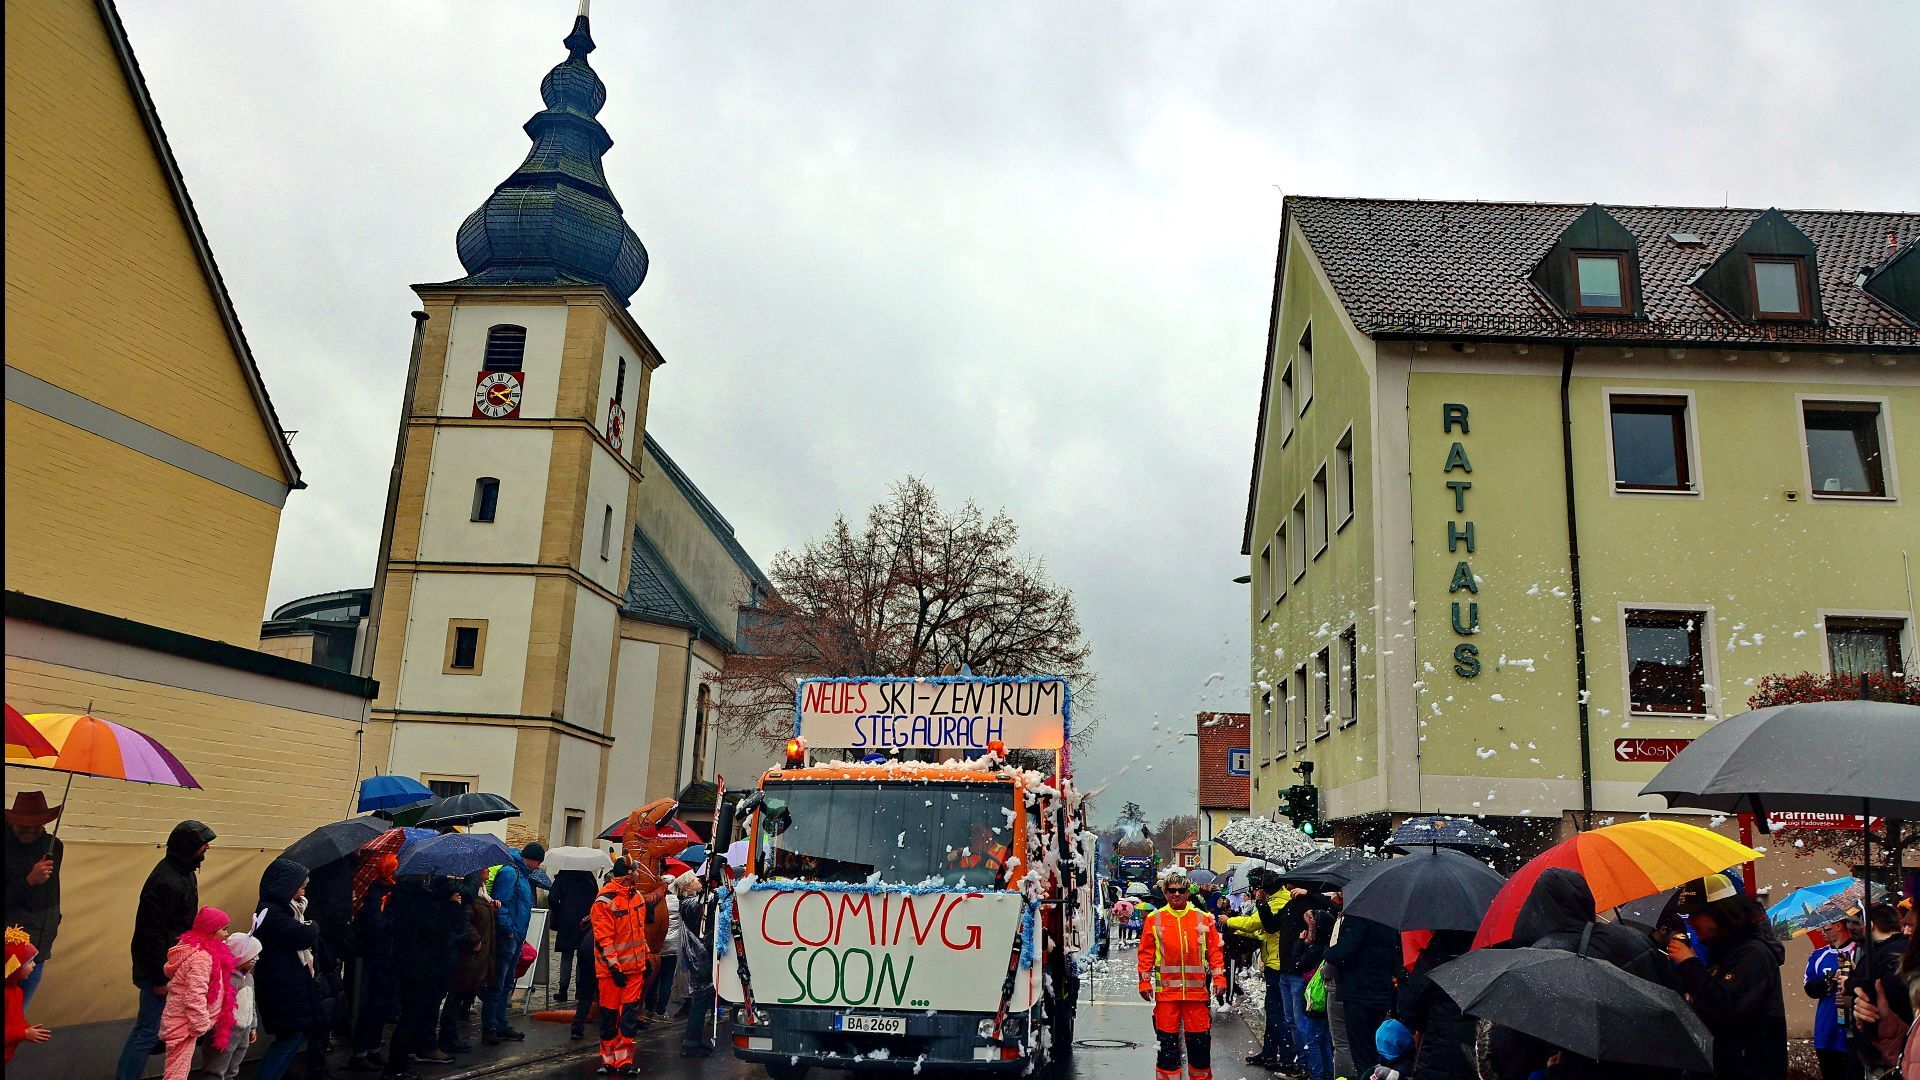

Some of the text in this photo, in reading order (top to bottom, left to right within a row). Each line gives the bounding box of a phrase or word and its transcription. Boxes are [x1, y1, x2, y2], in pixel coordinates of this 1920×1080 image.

[1443, 403, 1481, 678] RATHAUS
[804, 682, 1059, 716] NEUES SKI-ZENTRUM
[852, 715, 1003, 748] STEGAURACH
[1636, 740, 1692, 760] KosN
[761, 890, 985, 950] COMING
[777, 946, 930, 1006] SOON...
[848, 1017, 899, 1032] BA 2669
